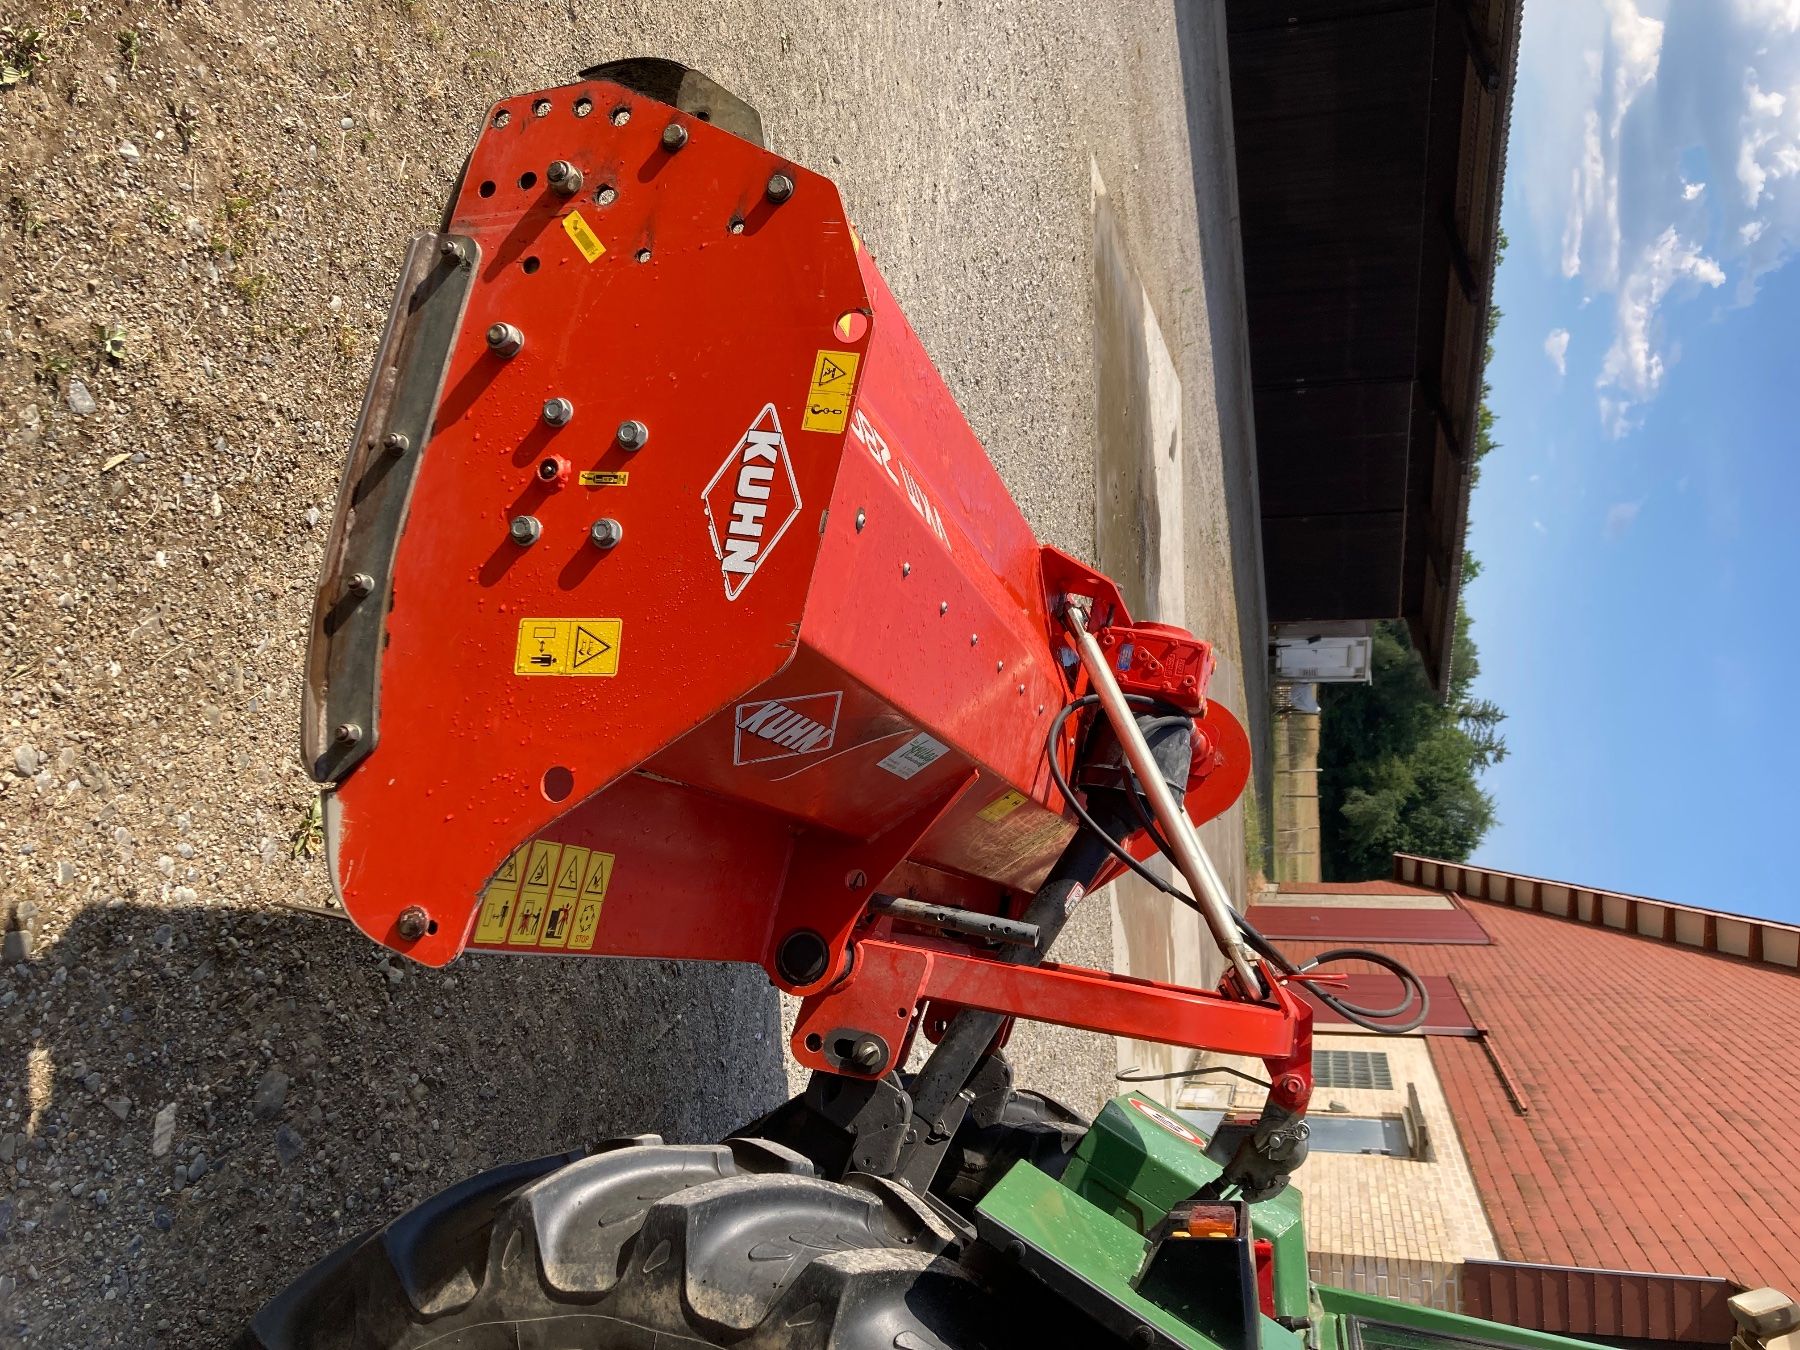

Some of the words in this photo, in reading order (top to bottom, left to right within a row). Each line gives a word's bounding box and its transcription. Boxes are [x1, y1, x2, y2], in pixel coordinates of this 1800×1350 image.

[722, 429, 782, 574] KUHN
[738, 700, 833, 754] KUHN
[575, 934, 590, 943] STOP
